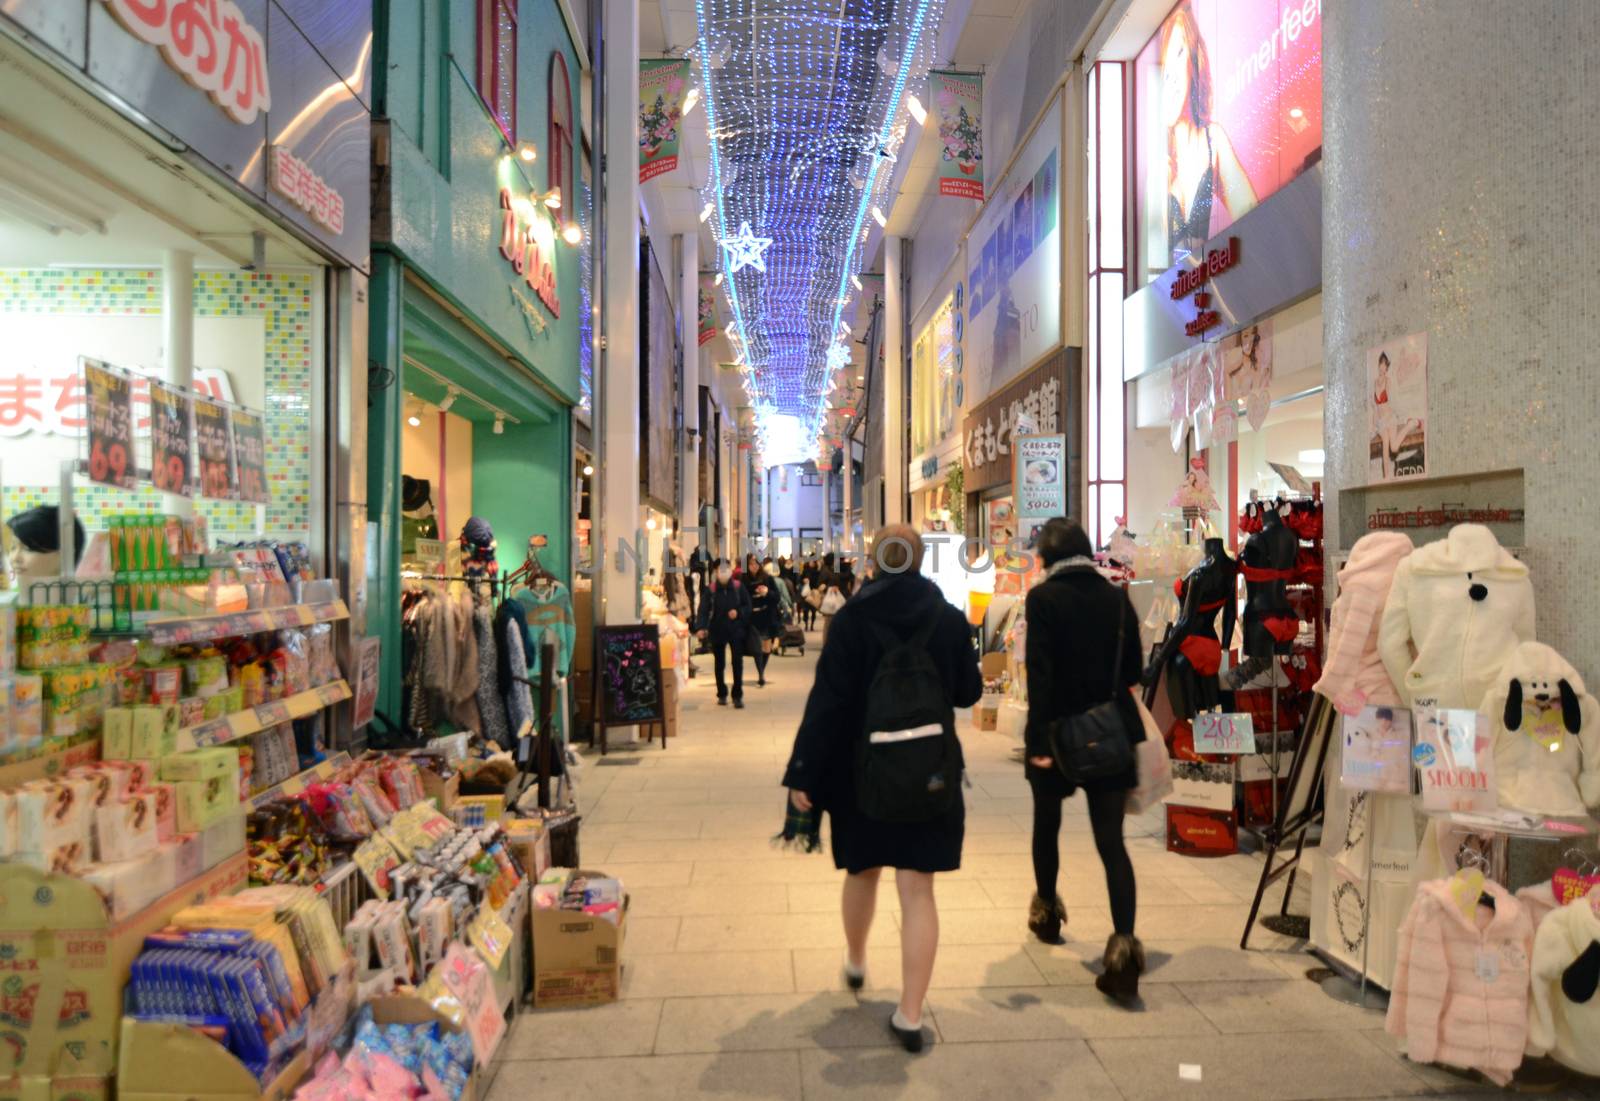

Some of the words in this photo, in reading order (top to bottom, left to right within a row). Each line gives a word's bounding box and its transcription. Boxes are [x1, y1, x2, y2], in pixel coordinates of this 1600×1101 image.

[278, 150, 343, 231] 吉祥寺店
[1428, 769, 1488, 789] SNOOPY
